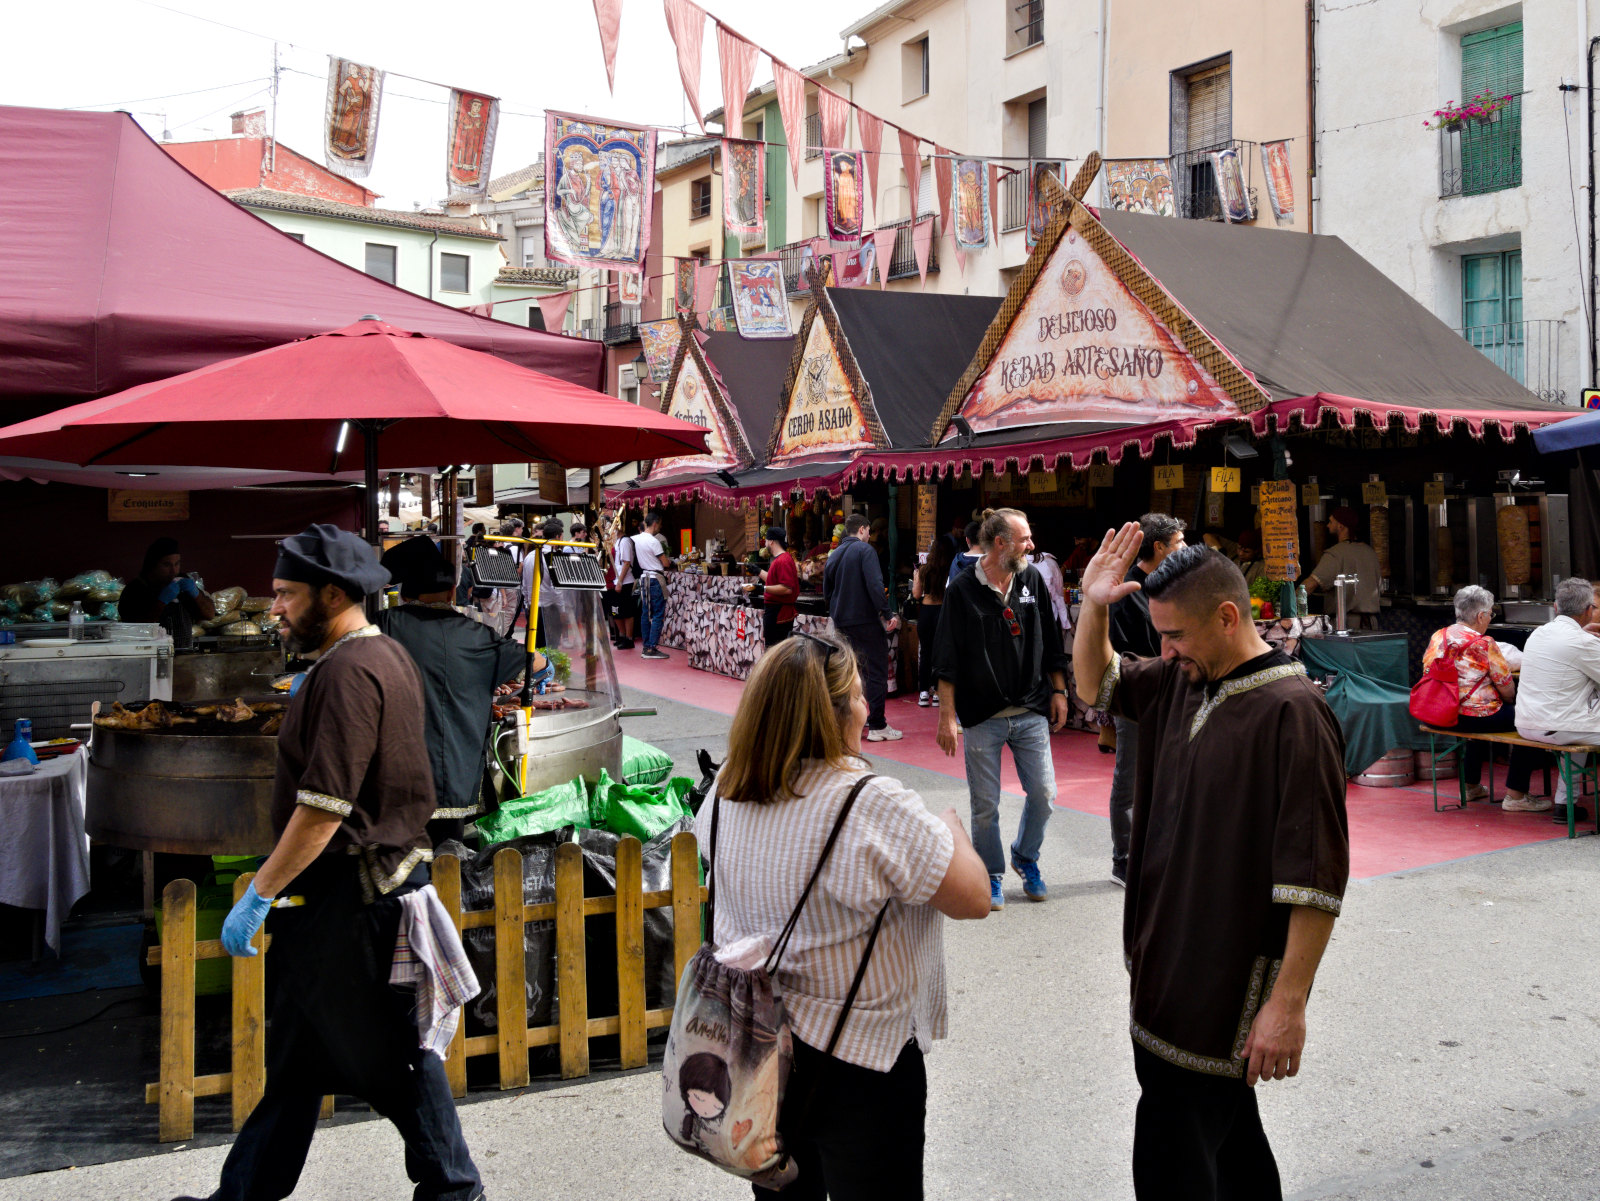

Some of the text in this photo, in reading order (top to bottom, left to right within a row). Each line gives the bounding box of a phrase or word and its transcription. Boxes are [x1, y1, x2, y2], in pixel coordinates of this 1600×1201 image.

[1038, 308, 1117, 343] DELICIOSO
[1001, 344, 1164, 394] KEBAB ARTESANO
[788, 406, 852, 438] CERDO ASADO
[1158, 467, 1175, 479] FILA
[1215, 470, 1235, 483] FILA
[1222, 482, 1229, 492] 1
[123, 498, 174, 509] Croquetas
